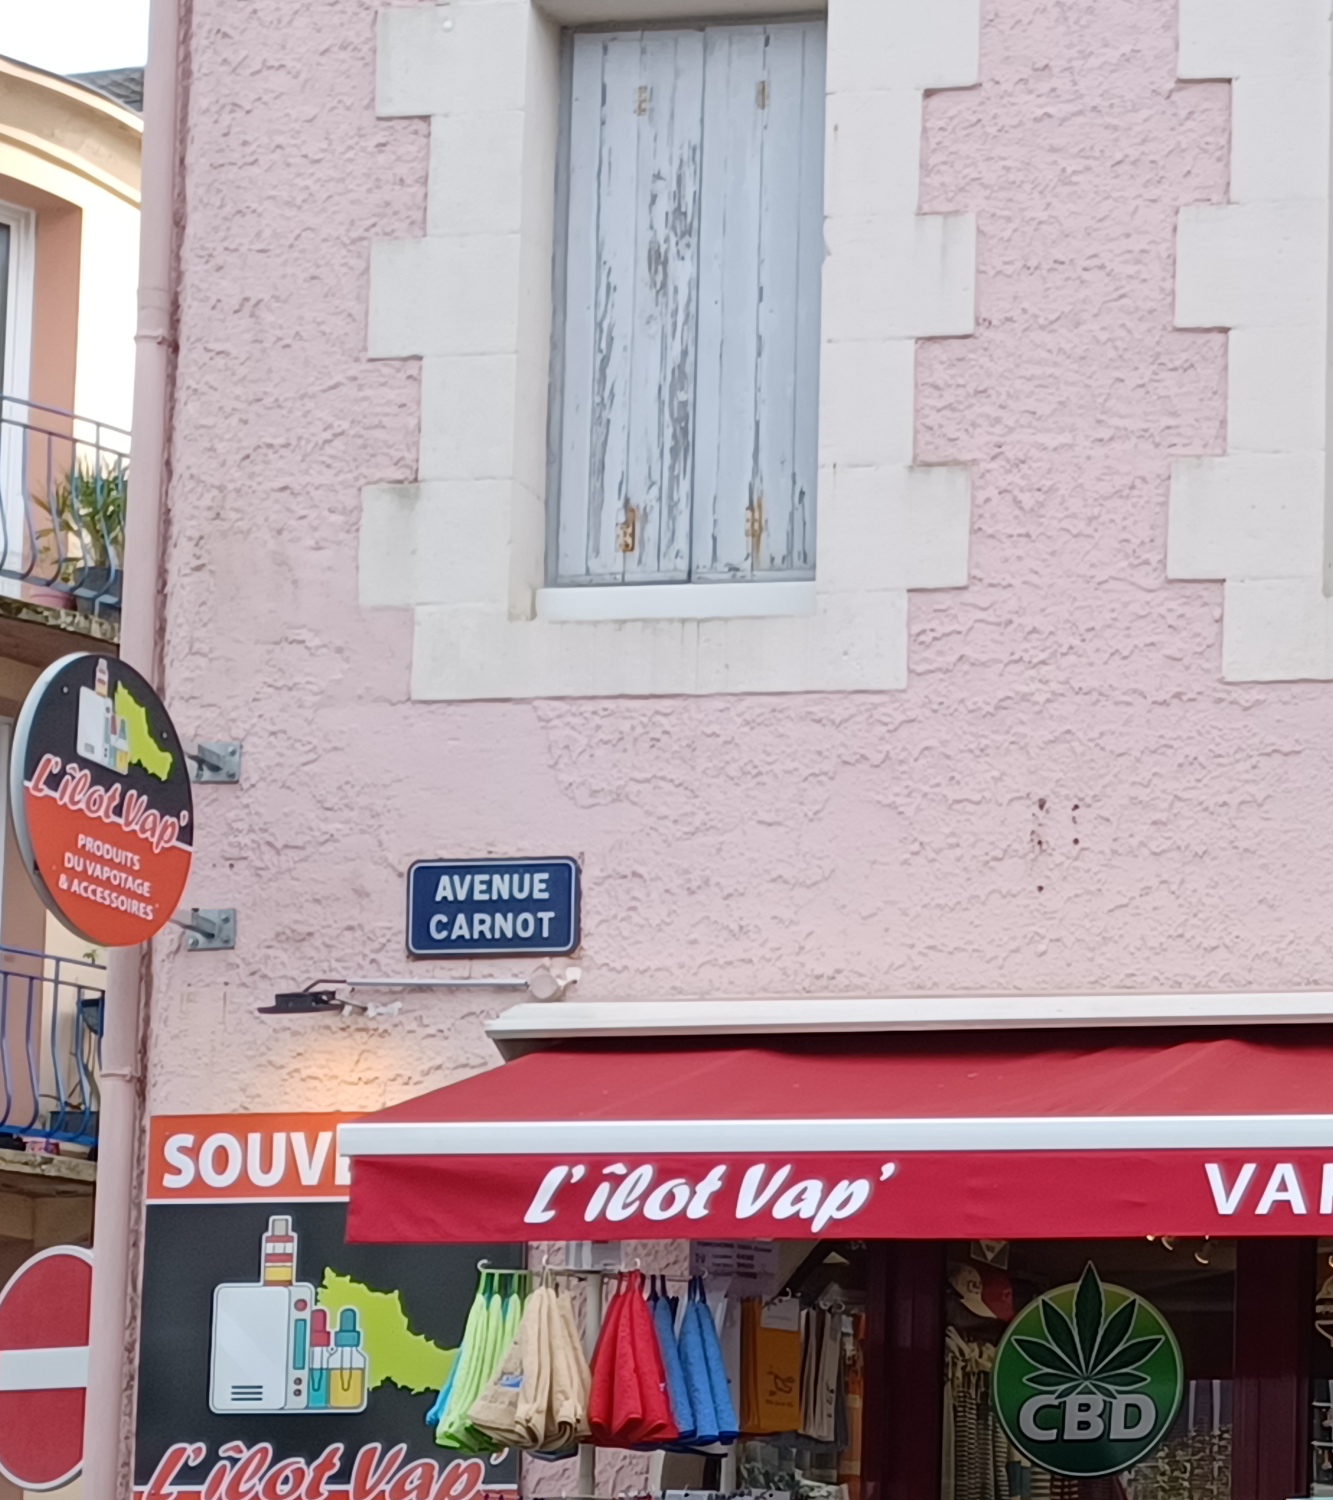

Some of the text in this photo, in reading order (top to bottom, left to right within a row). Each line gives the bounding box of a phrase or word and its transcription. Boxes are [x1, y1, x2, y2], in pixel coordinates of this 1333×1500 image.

[30, 754, 188, 853] L'îlot Vap'
[64, 852, 151, 897] DU VAPOTAGE
[77, 834, 140, 870] PRODUITS
[58, 874, 153, 920] & ACCESSOIRES
[435, 873, 550, 902] AVENUE
[429, 911, 555, 940] CARNOT
[162, 1130, 350, 1189] SOUV
[524, 1162, 896, 1233] L'îlot Vap'
[1019, 1394, 1156, 1441] CBD
